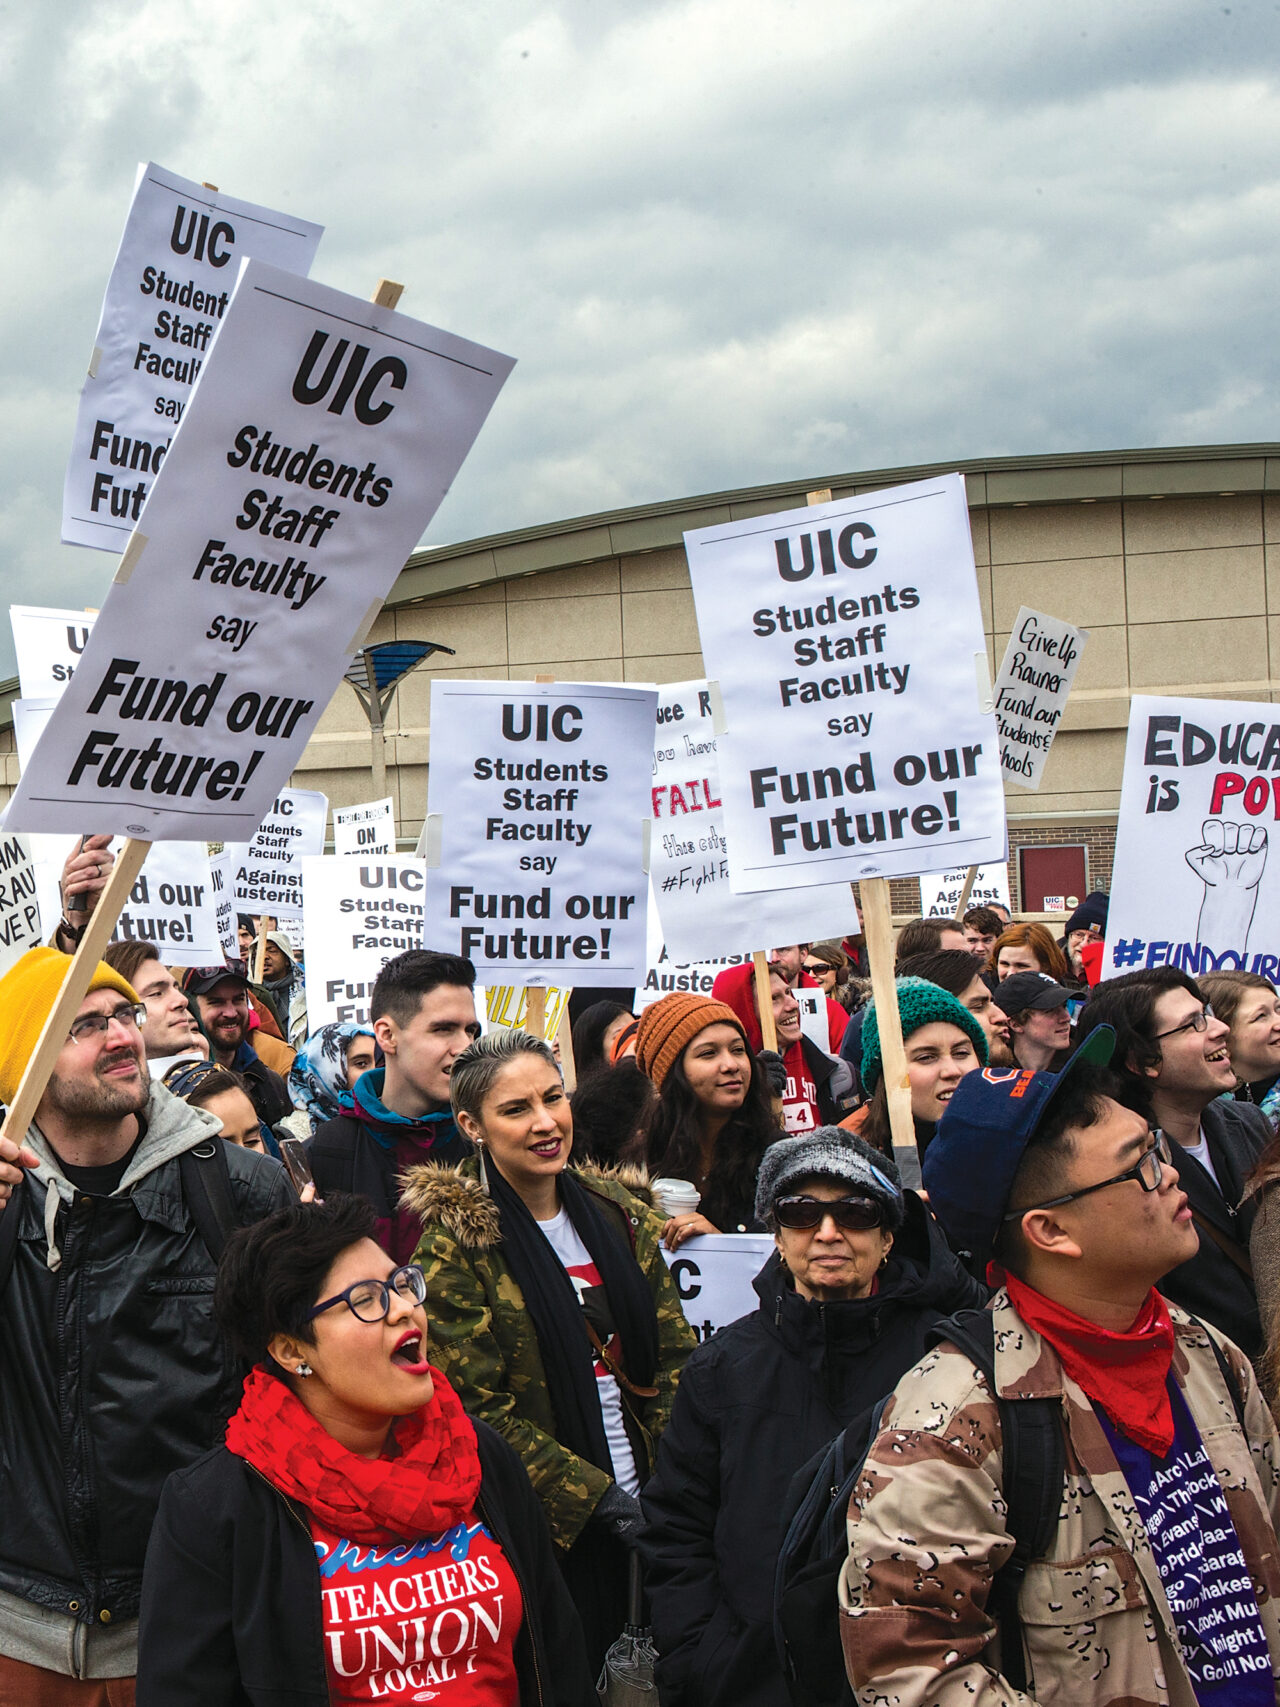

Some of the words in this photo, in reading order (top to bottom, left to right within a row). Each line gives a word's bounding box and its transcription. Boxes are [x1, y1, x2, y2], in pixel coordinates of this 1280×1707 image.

[171, 205, 234, 268] UIC
[140, 266, 228, 319] Student
[154, 310, 212, 351] Staff
[134, 342, 202, 385] Facul
[292, 330, 407, 425] UIC
[154, 397, 185, 424] say
[227, 425, 394, 508] Students
[236, 489, 340, 548] Staff
[774, 521, 878, 583] UIC
[192, 540, 326, 610] Faculty
[753, 585, 920, 636] Students
[206, 615, 258, 652] say
[794, 624, 886, 666] Staff
[1019, 617, 1058, 657] Give
[1058, 634, 1077, 669] Up
[780, 662, 910, 707] Faculty
[1010, 652, 1067, 694] Rauner
[86, 658, 227, 727] Fund
[227, 692, 314, 738] our
[657, 703, 685, 724] uce
[995, 687, 1037, 720] Fund
[1034, 709, 1061, 726] our
[502, 704, 582, 742] UIC
[828, 712, 872, 737] say
[1000, 744, 1033, 778] hools
[1144, 715, 1280, 770] EDUCA
[67, 730, 265, 801] Future!
[474, 758, 608, 782] Students
[750, 752, 876, 808] Fund
[894, 744, 982, 786] our
[503, 788, 578, 811] Staff
[651, 778, 722, 819] FAIL
[1146, 774, 1179, 814] is
[258, 824, 302, 837] udents
[358, 827, 375, 845] ON
[487, 818, 592, 846] Faculty
[770, 790, 960, 855] Future!
[248, 847, 294, 863] Faculty
[257, 835, 289, 848] Staff
[663, 834, 696, 858] this
[236, 867, 302, 887] Against
[360, 867, 424, 891] UIC
[520, 856, 557, 875] say
[944, 872, 984, 883] Facuy
[159, 884, 204, 906] our
[234, 886, 303, 908] usterity
[340, 898, 426, 915] Studen
[450, 886, 550, 919] Fund
[566, 895, 635, 919] our
[936, 887, 999, 903] Aganst
[111, 914, 193, 942] ture!
[352, 935, 424, 950] Facult
[364, 916, 424, 933] Staff
[460, 926, 612, 960] Future!
[1112, 938, 1280, 985] #FUNDOUR
[644, 969, 714, 992] Auste
[1156, 1464, 1182, 1490] Arc
[314, 1521, 493, 1579] hicag
[322, 1555, 499, 1624] TEACHERS
[325, 1595, 503, 1677] UNION
[1210, 1628, 1256, 1654] Knight
[369, 1658, 456, 1698] LOCAL
[466, 1654, 477, 1674] 1
